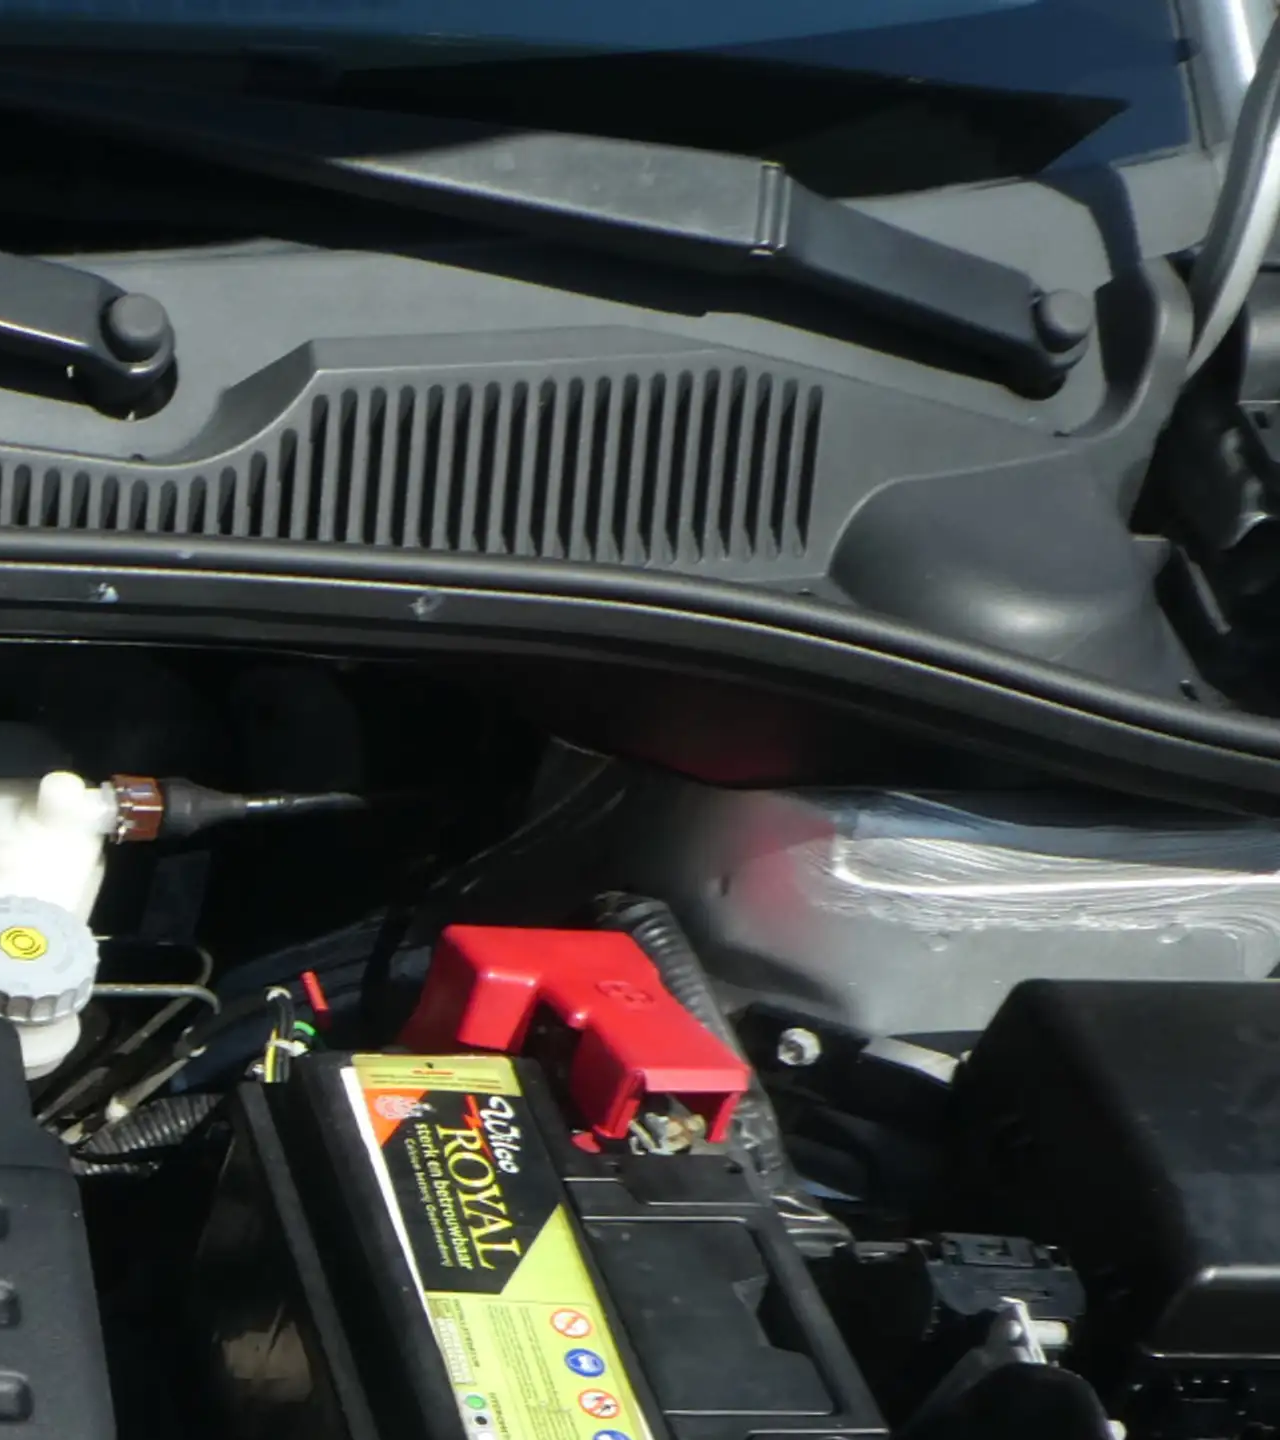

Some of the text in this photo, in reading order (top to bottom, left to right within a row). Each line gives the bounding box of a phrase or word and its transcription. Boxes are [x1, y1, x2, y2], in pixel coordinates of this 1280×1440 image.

[414, 1123, 475, 1270] sterk en betrouwbaar
[434, 1123, 522, 1270] ROYAL
[479, 1095, 522, 1174] Wilco
